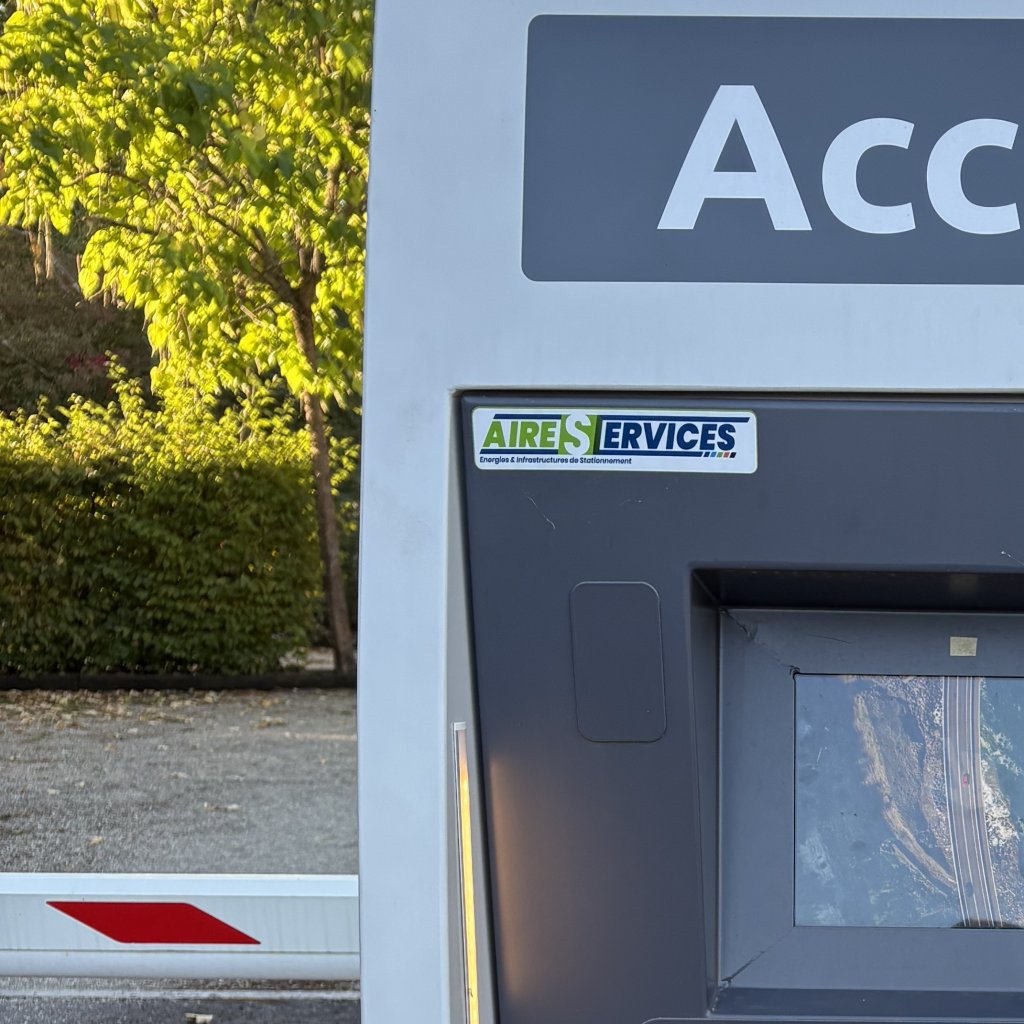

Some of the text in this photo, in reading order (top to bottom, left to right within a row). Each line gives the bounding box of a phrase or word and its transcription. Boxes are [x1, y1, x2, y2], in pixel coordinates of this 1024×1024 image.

[480, 456, 509, 464] Energies
[516, 456, 569, 464] Infrastructures
[580, 457, 632, 465] Stationnement
